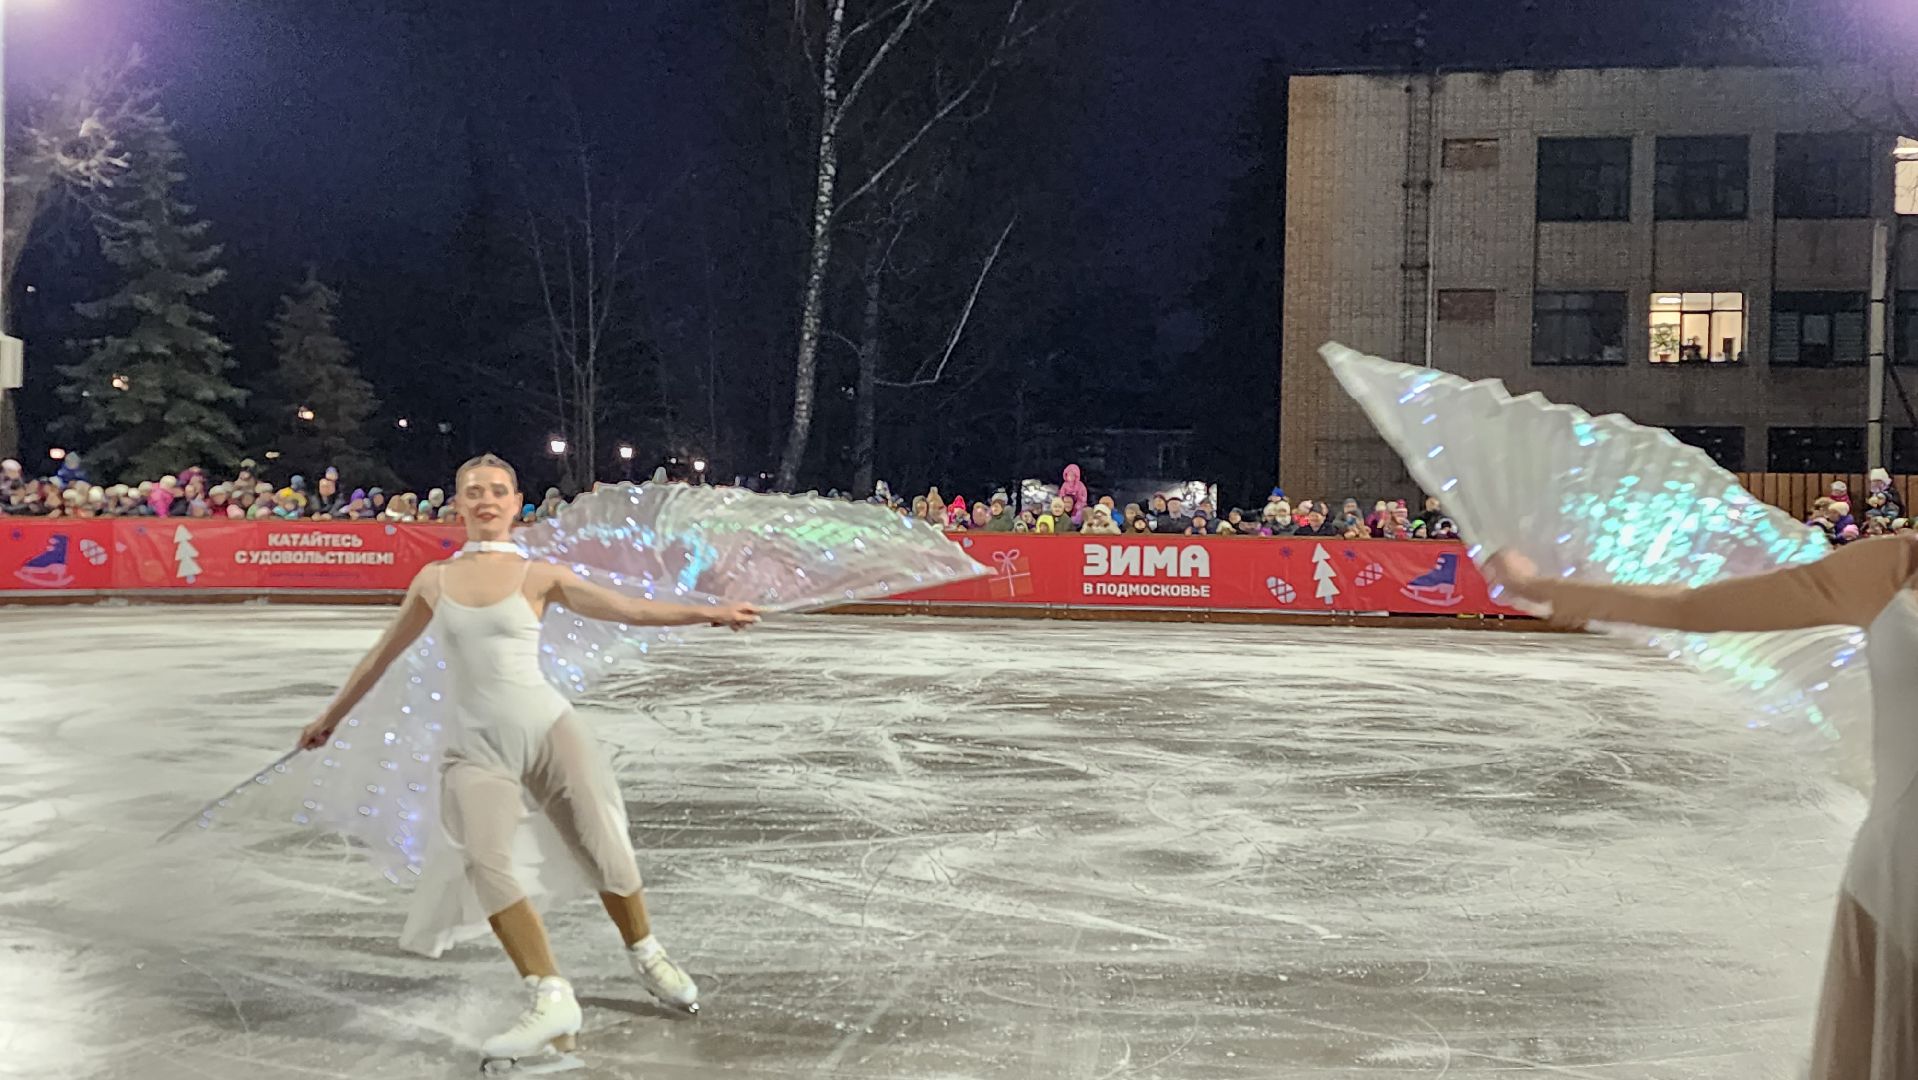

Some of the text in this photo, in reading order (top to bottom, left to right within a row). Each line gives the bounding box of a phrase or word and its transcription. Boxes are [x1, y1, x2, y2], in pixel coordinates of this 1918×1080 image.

[268, 531, 362, 547] КАТАЙТЕСЬ
[235, 550, 393, 565] С УДОВОЛЬСТВИЕМ!
[1083, 544, 1210, 577] ЗИМА
[1083, 582, 1210, 598] В ПОДМОСКОВЬЕ
